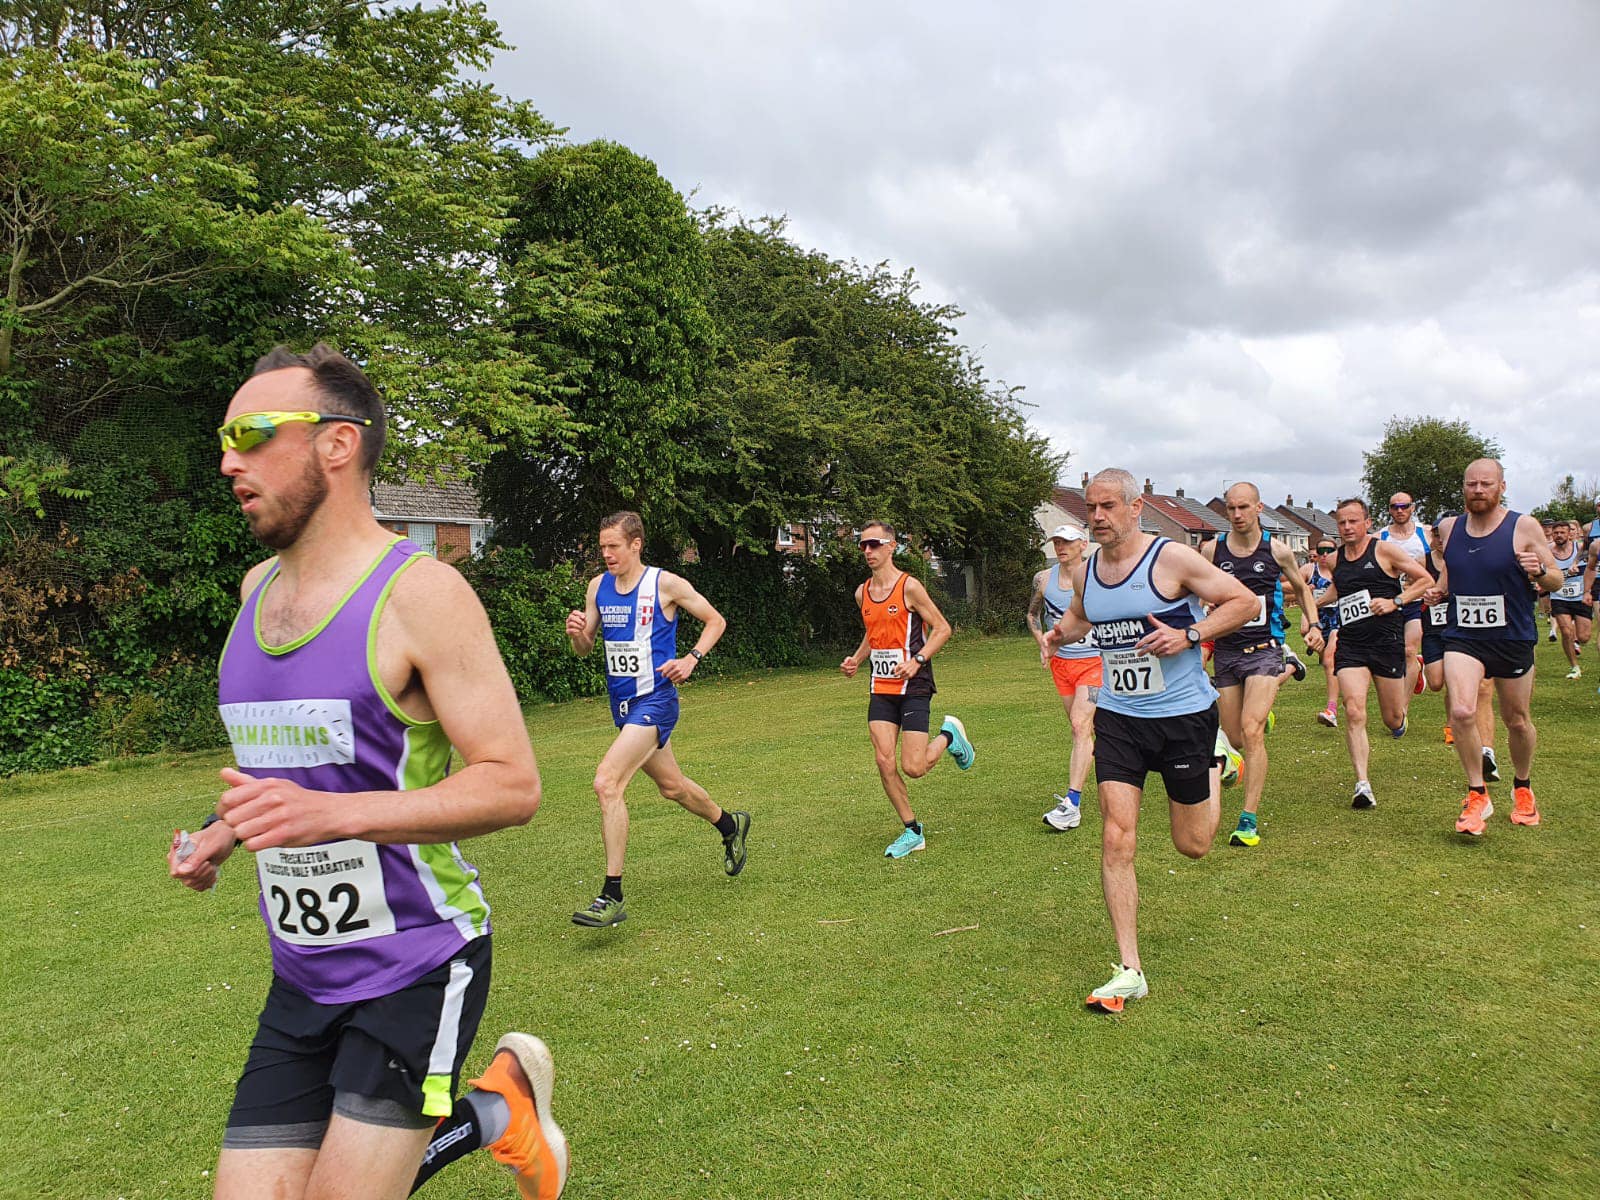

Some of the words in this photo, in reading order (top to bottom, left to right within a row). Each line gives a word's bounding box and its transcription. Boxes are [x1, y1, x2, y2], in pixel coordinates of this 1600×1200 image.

[1343, 602, 1370, 621] 205
[1461, 608, 1498, 625] 216
[610, 655, 640, 673] 193
[1113, 667, 1151, 691] 207
[230, 725, 330, 747] SAMARITANS
[311, 856, 365, 877] MARATHON
[271, 882, 370, 936] 282
